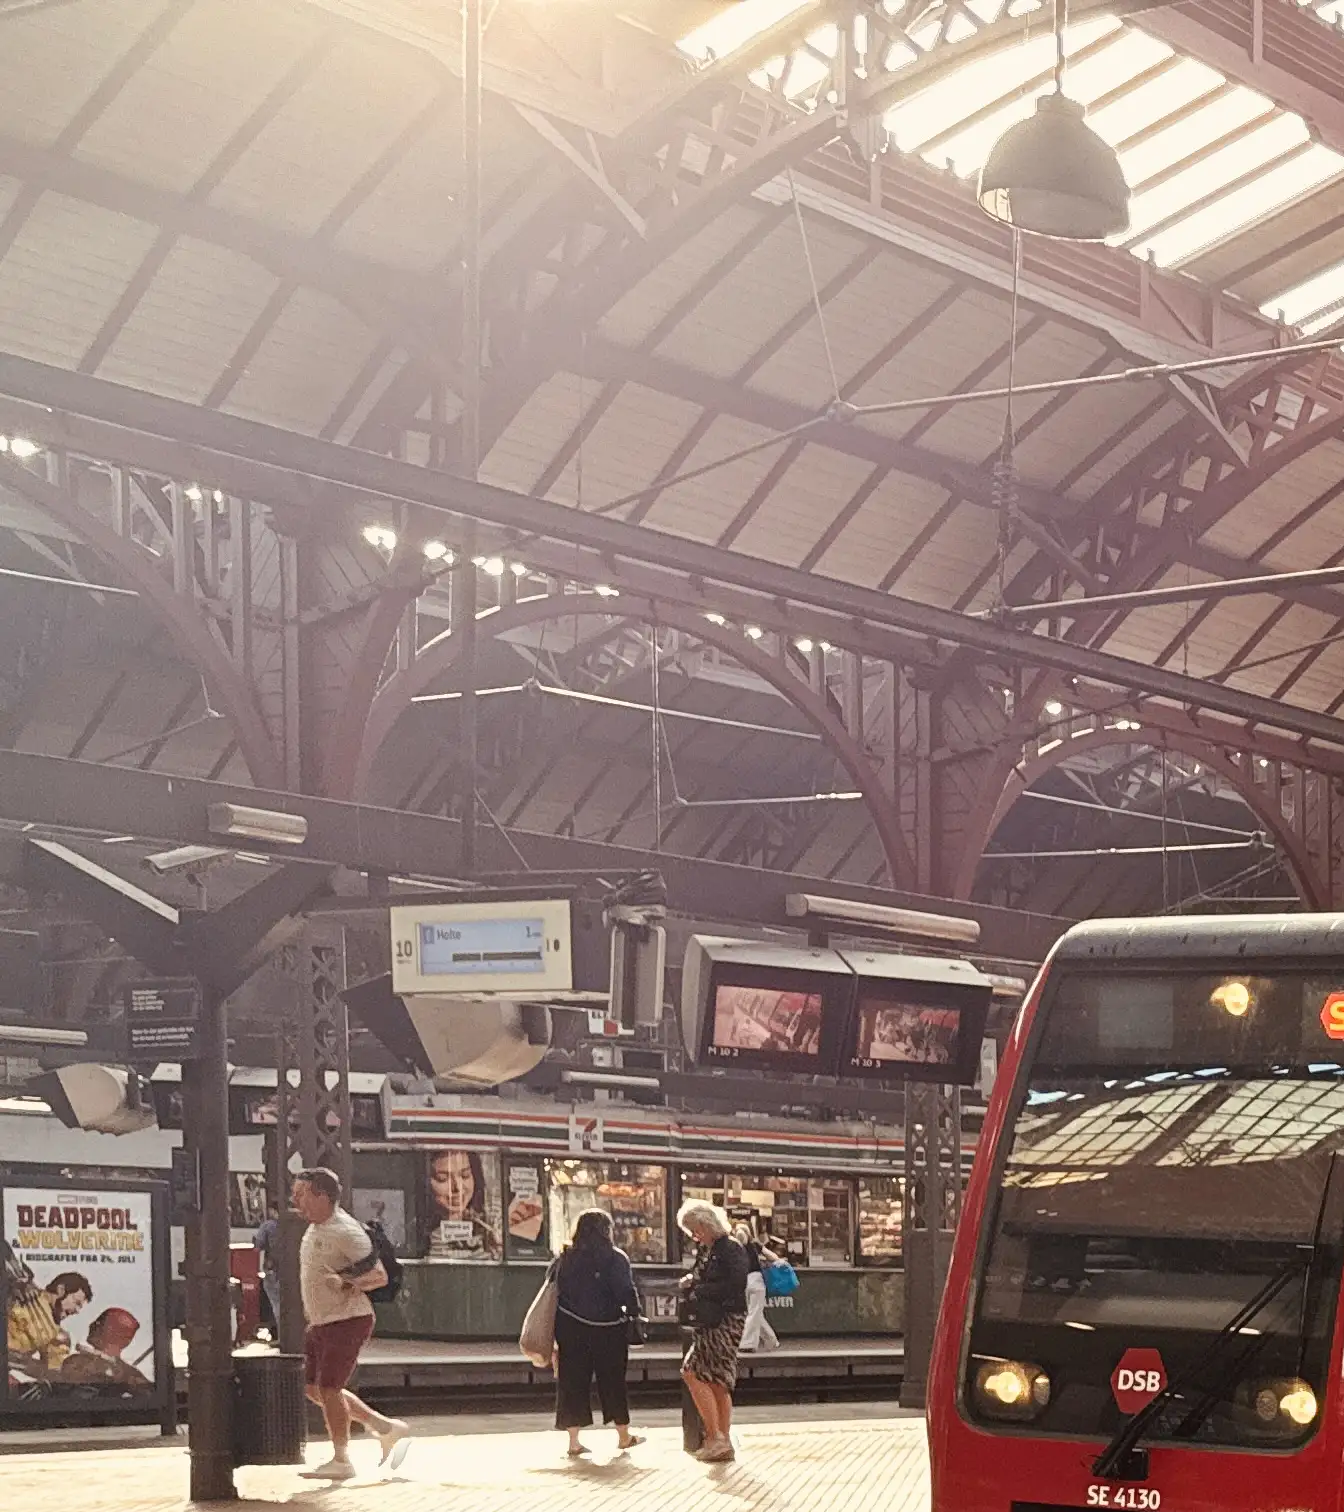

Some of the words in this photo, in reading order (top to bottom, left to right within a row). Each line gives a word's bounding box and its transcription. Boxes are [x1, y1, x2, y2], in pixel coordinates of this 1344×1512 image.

[396, 940, 413, 957] 10
[720, 1046, 731, 1057] 10
[17, 1204, 138, 1230] DEADPOOL
[18, 1229, 145, 1252] WOLVERINE
[26, 1253, 77, 1263] BIOGRAFEN
[80, 1254, 98, 1264] FRA
[117, 1254, 136, 1264] JULI
[1117, 1369, 1161, 1393] DSB
[1086, 1484, 1111, 1506] SE
[1113, 1486, 1161, 1511] 4130
